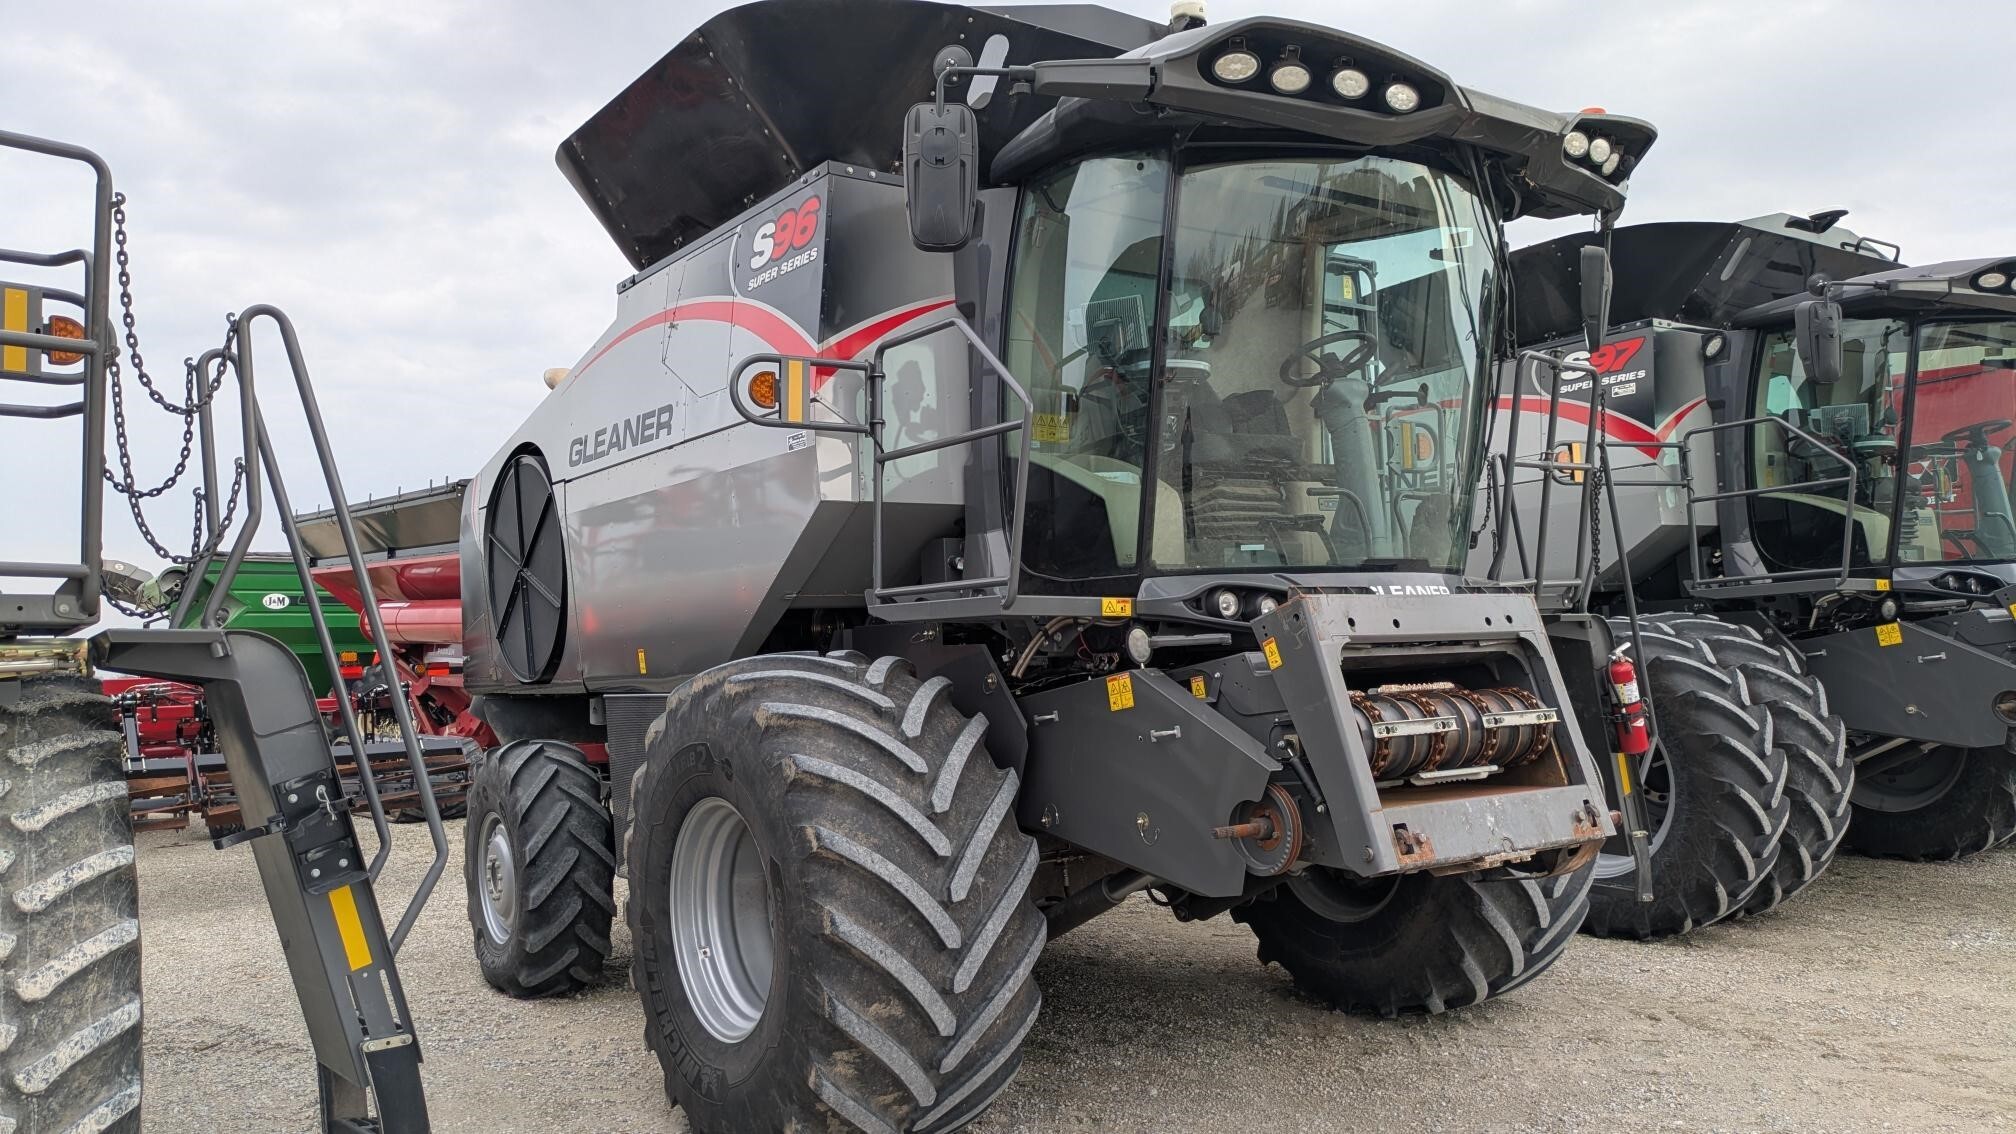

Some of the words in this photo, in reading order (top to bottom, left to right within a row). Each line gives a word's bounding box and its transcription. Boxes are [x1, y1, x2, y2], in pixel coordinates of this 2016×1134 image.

[750, 195, 821, 270] S96
[747, 266, 779, 291] SUPER
[780, 247, 818, 275] SERIES
[1560, 336, 1646, 380] S97
[1601, 369, 1646, 386] SERIES
[568, 403, 674, 468] GLEANER
[267, 596, 286, 607] J&M
